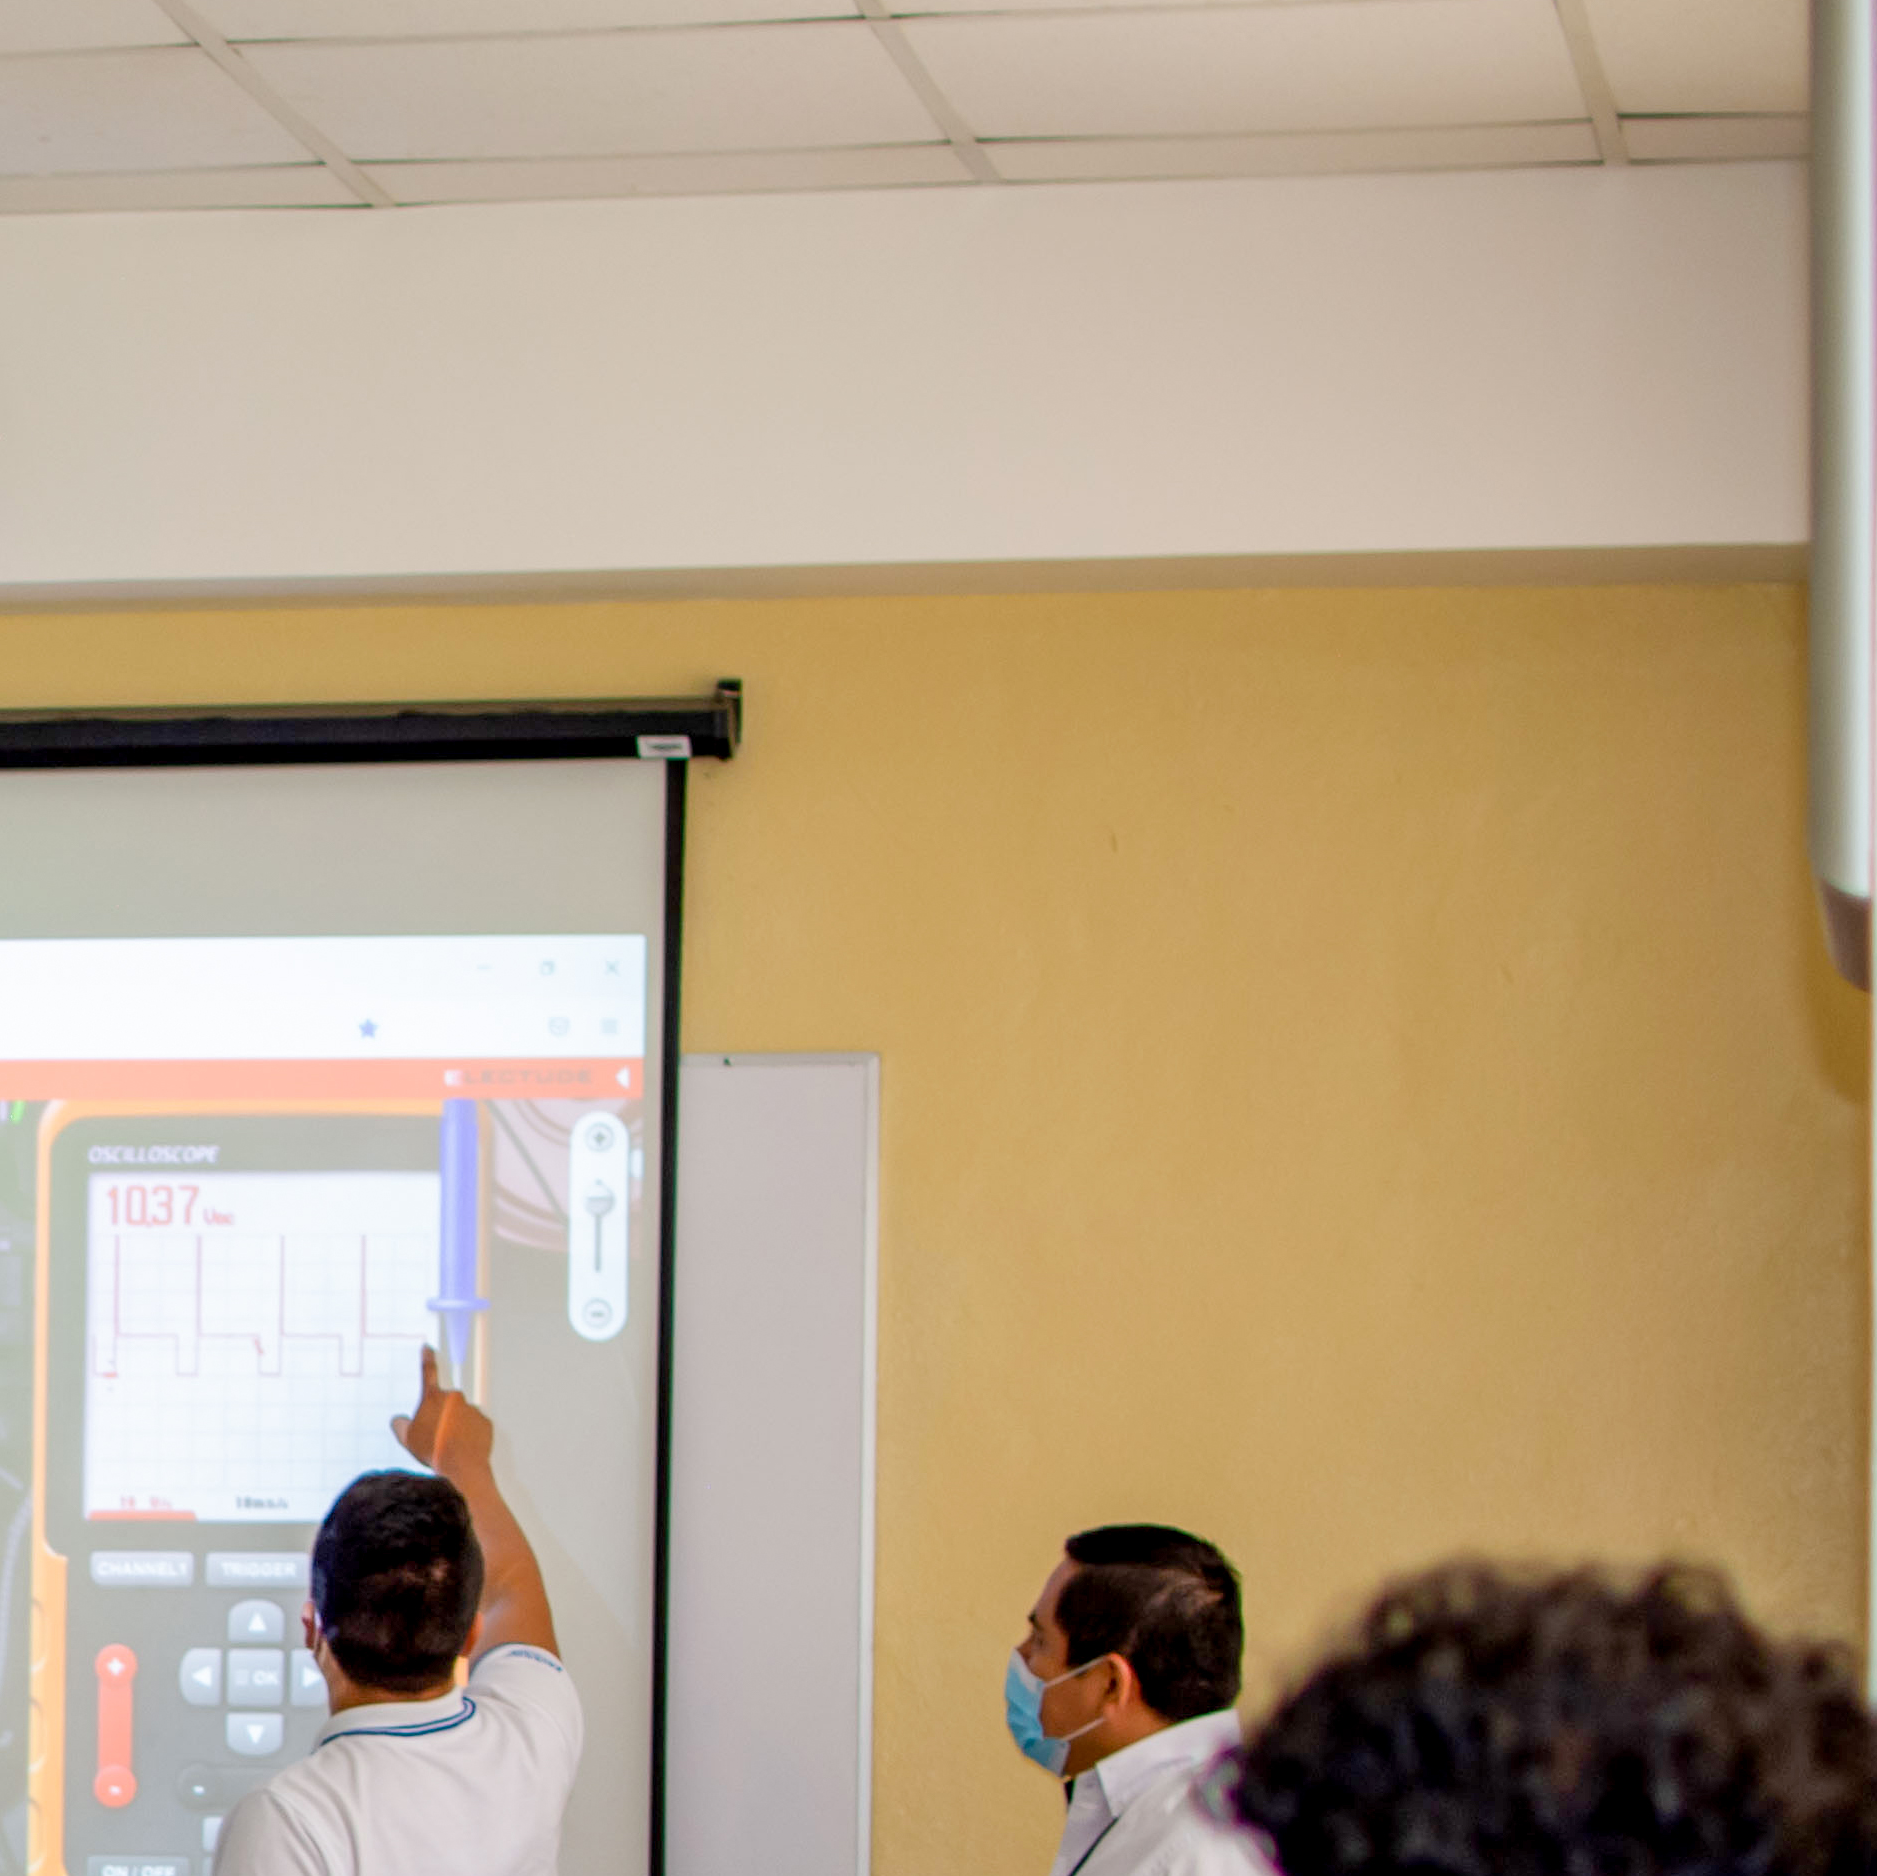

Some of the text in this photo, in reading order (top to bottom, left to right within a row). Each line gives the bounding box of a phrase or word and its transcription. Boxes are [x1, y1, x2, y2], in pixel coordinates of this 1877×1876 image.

[88, 1145, 221, 1164] OSCILLOSCOPE
[221, 1561, 297, 1578] TRIGGER
[252, 1669, 279, 1686] OK
